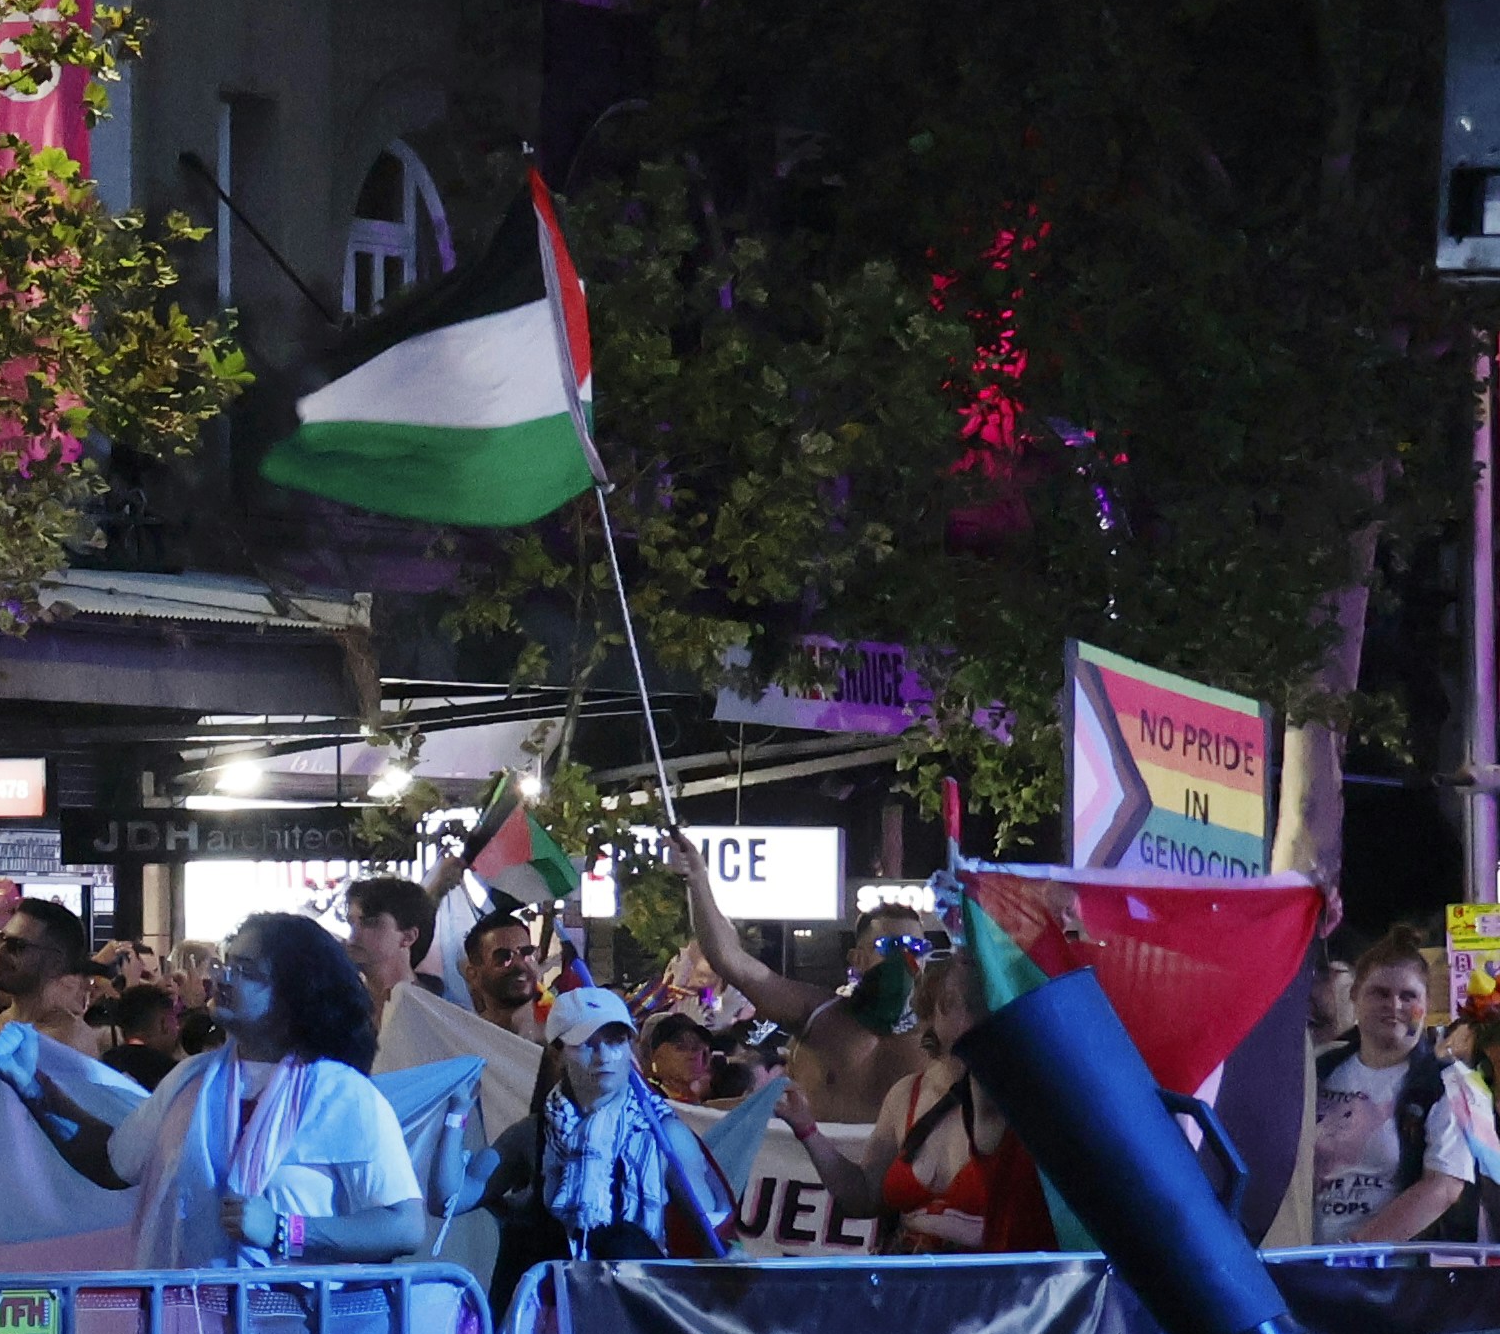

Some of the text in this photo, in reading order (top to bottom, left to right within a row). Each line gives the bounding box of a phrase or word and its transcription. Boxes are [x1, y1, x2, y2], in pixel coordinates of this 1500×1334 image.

[1140, 708, 1256, 777] NO PRIDE
[1185, 788, 1210, 826] IN
[92, 820, 199, 853] JDH
